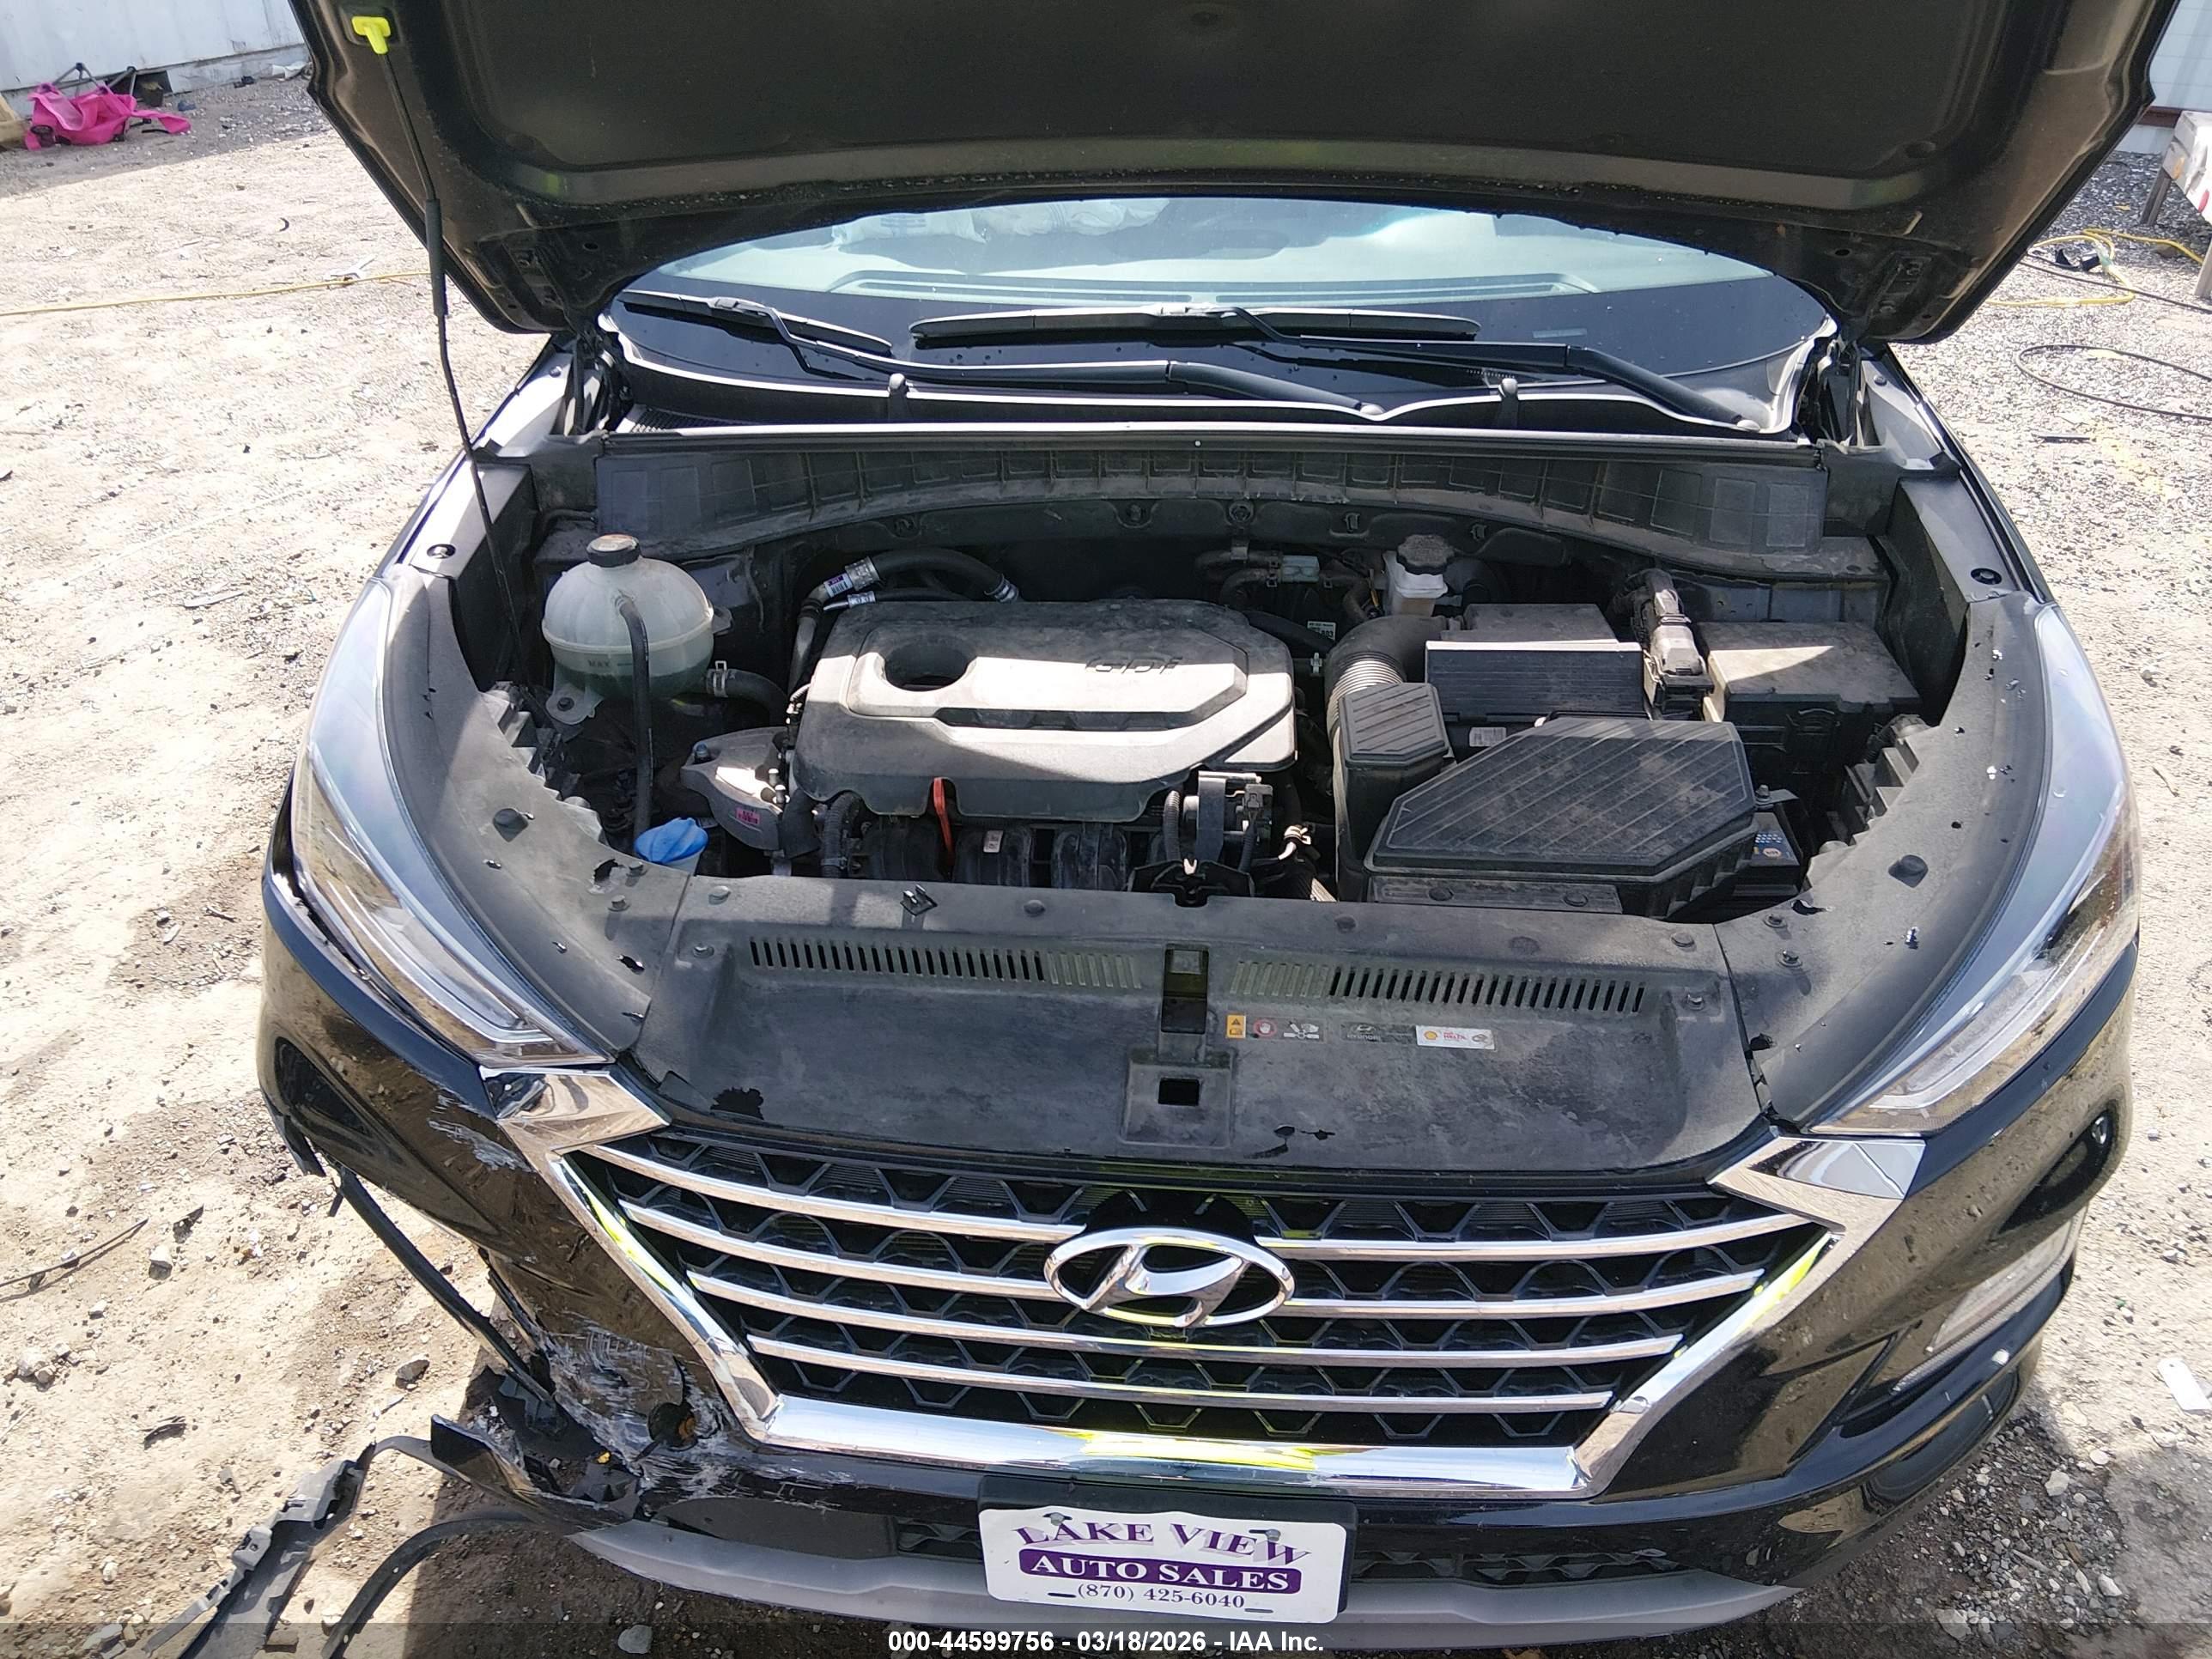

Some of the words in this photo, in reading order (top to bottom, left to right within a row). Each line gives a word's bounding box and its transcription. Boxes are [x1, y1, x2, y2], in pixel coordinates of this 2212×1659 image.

[1014, 1518, 1155, 1548] LAKE
[1169, 1523, 1310, 1565] VIEW
[1030, 1556, 1149, 1580] AUTO
[1158, 1564, 1290, 1591] SALES
[1078, 1583, 1134, 1603] (870)
[1144, 1589, 1245, 1609] 425-6040
